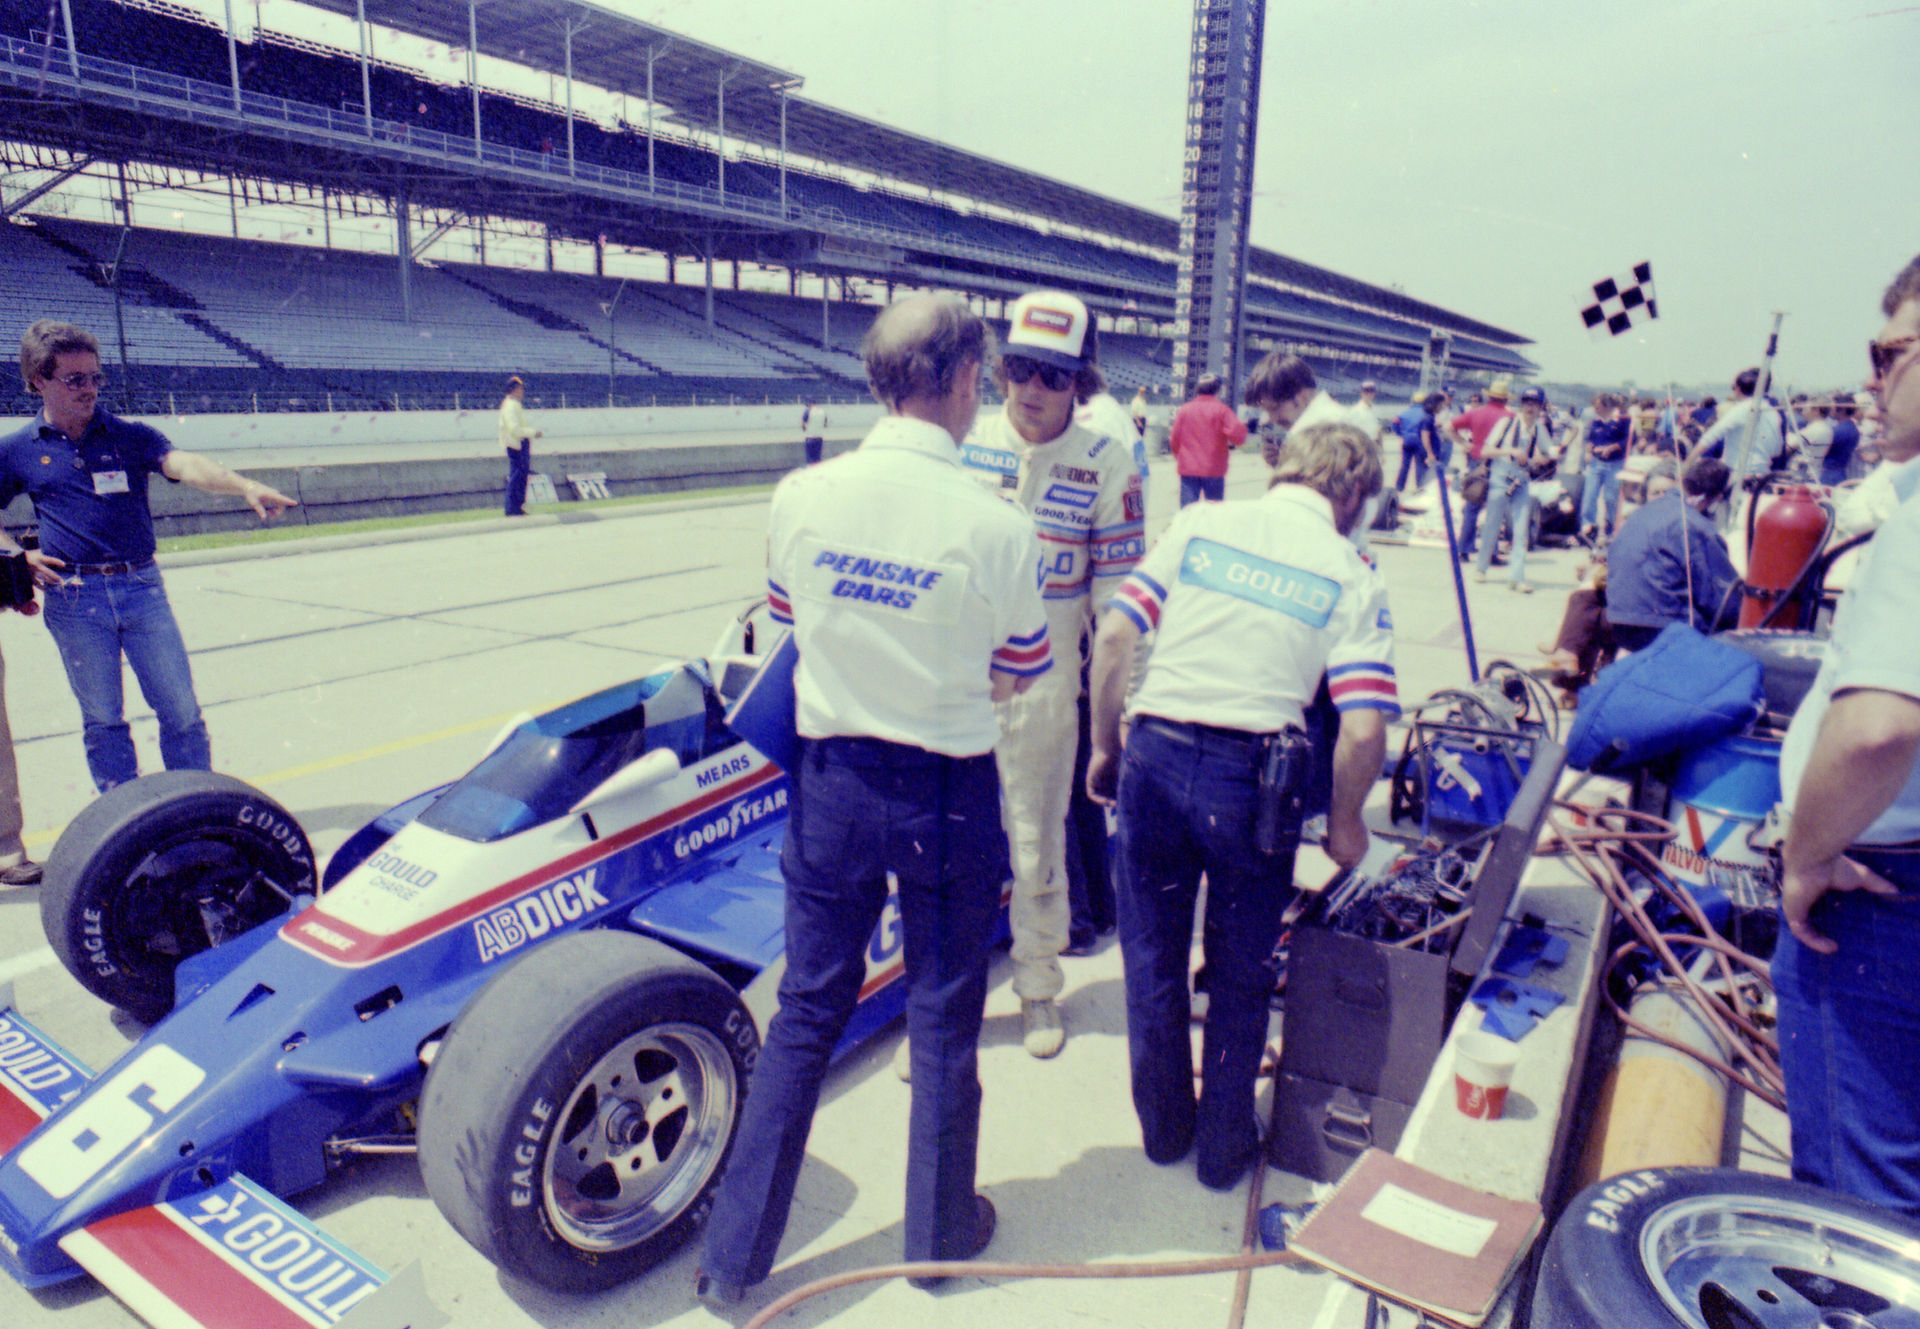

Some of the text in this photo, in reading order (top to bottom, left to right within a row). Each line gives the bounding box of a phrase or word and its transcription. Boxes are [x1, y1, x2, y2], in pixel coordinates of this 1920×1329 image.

[1194, 15, 1208, 32] 14
[1193, 37, 1207, 53] 15
[1191, 58, 1206, 75] 16
[1190, 80, 1205, 97] 17
[1189, 102, 1203, 119] 18
[1187, 123, 1202, 140] 19
[1184, 146, 1200, 162] 20
[1183, 168, 1198, 183] 21
[1181, 213, 1196, 229] 23
[1179, 233, 1195, 249] 24
[1178, 255, 1194, 272] 25
[1177, 278, 1193, 293] 26
[1176, 299, 1191, 314] 27
[1174, 320, 1190, 334] 28
[1173, 341, 1189, 357] 29
[1172, 362, 1187, 378] 30
[1170, 383, 1184, 398] 31
[969, 451, 1017, 470] GOULD
[575, 478, 609, 500] PIT
[813, 550, 943, 590] PENSKE
[832, 578, 917, 609] CARS
[1226, 562, 1332, 613] GOULD
[696, 754, 751, 788] MEARS
[674, 788, 788, 859] GOODYEAR
[367, 851, 438, 888] GOULD
[83, 908, 117, 977] EAGLE
[17, 1043, 207, 1199] 6
[511, 1097, 553, 1207] EAGLE
[1586, 1171, 1666, 1234] EAGLE
